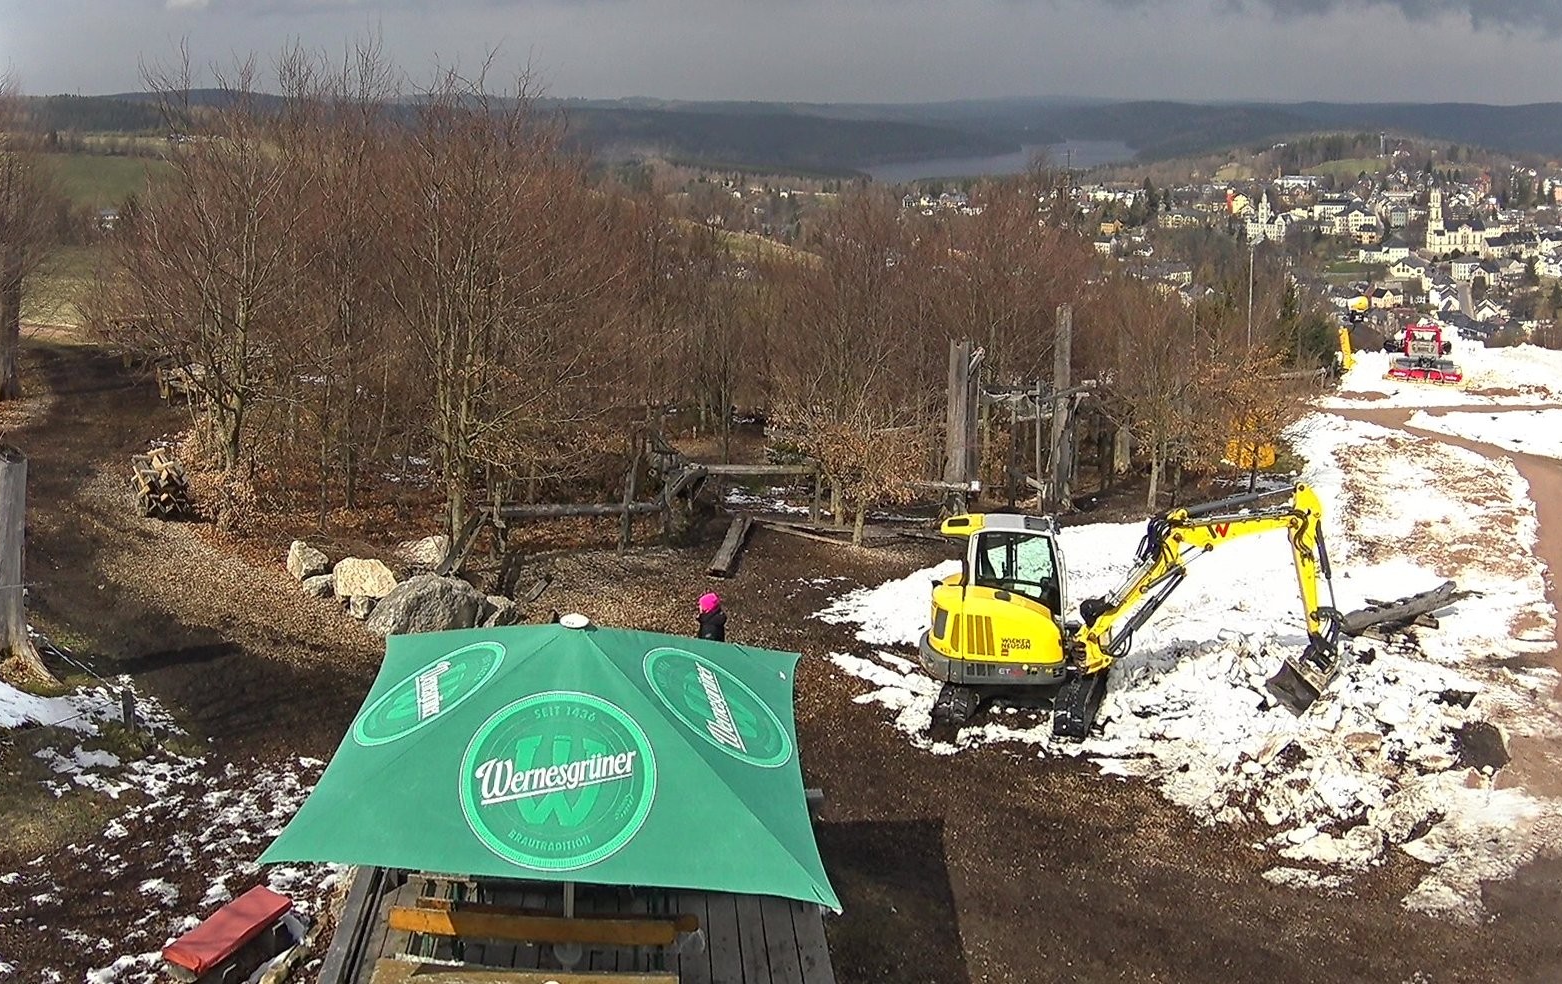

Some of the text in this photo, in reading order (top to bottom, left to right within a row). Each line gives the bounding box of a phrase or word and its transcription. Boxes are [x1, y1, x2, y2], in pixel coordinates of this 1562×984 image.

[534, 706, 560, 719] SEIT
[475, 750, 637, 799] Wernesgrüner
[507, 828, 591, 851] BRAUTRADITION
